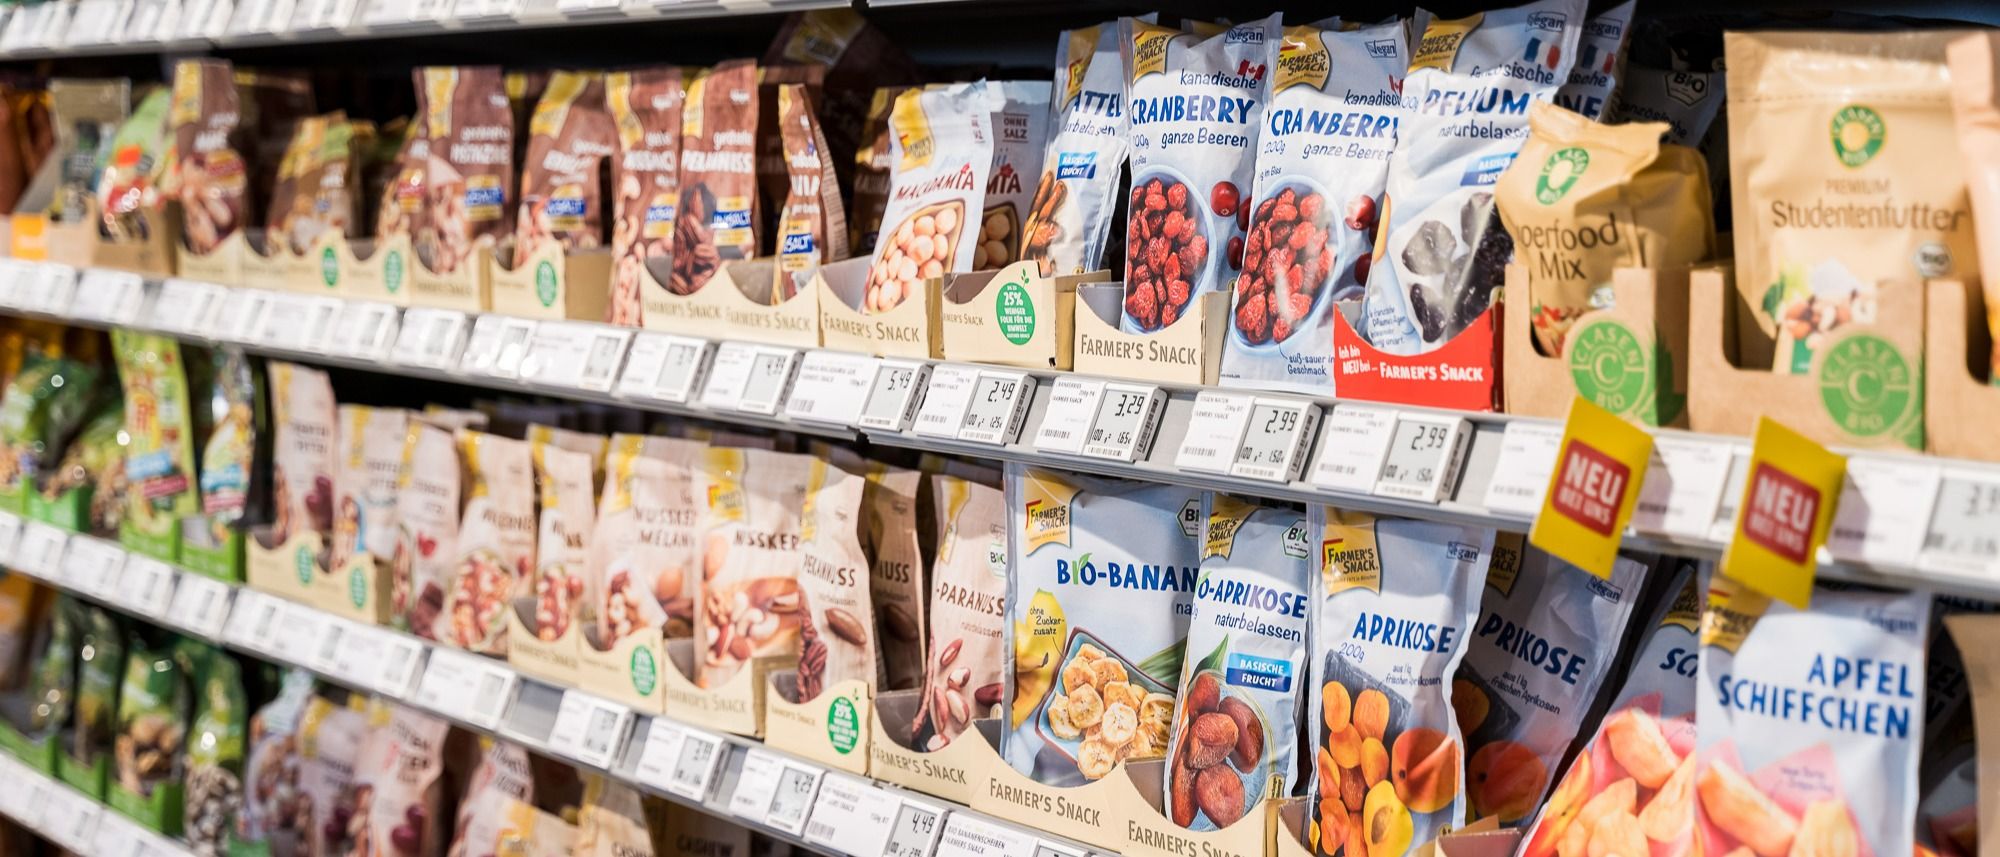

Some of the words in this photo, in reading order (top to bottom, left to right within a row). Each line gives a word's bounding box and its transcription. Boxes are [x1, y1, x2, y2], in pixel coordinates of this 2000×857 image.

[1180, 68, 1257, 90] kanadische
[1003, 117, 1028, 128] OHNE
[1132, 95, 1256, 126] CRANBERRY
[1003, 128, 1028, 140] SALZ
[1161, 131, 1195, 150] ganze
[1197, 127, 1249, 149] Beeren
[1302, 143, 1342, 159] ganze
[1771, 198, 1969, 232] Studentenfutter
[1539, 252, 1587, 281] Mix
[1003, 291, 1024, 306] 25%
[823, 312, 873, 340] FARMER'S
[876, 320, 921, 344] SNACK
[1080, 333, 1144, 361] FARMER'S
[1148, 339, 1198, 366] SNACK
[1575, 325, 1640, 364] CLASEN
[1287, 363, 1328, 376] Geschmack
[1342, 359, 1360, 376] NEU
[1379, 361, 1437, 381] FARMER'S
[1439, 363, 1484, 382] SNACK
[1595, 352, 1618, 384] C
[987, 380, 1016, 402] 2.49
[1848, 370, 1878, 402] C
[1114, 393, 1145, 416] 3.29
[1264, 409, 1299, 434] 2.99
[1410, 425, 1448, 451] 2.99
[1565, 451, 1623, 508] NEU
[1030, 505, 1067, 524] FARMER'S
[1556, 486, 1583, 510] BEI
[1583, 498, 1611, 526] UNS
[1753, 475, 1814, 533] NEU
[1327, 547, 1375, 565] FARMER'S
[1029, 606, 1045, 616] ohne
[1033, 626, 1057, 636] zusatz
[1214, 611, 1302, 643] naturbelassen
[1353, 611, 1456, 654] APRIKOSE
[1339, 641, 1365, 663] 200g
[1239, 658, 1285, 675] BASISCHE
[1807, 653, 1915, 699] APFEL
[1241, 672, 1278, 688] FRUCHT
[1718, 674, 1911, 740] SCHIFFCHEN
[872, 741, 921, 774] FARMER'S
[923, 759, 968, 785] SNACK
[989, 777, 1052, 813] FARMER'S
[1056, 796, 1101, 828] SNACK
[912, 812, 935, 834] 4.49
[1128, 820, 1197, 857] FARMER'S
